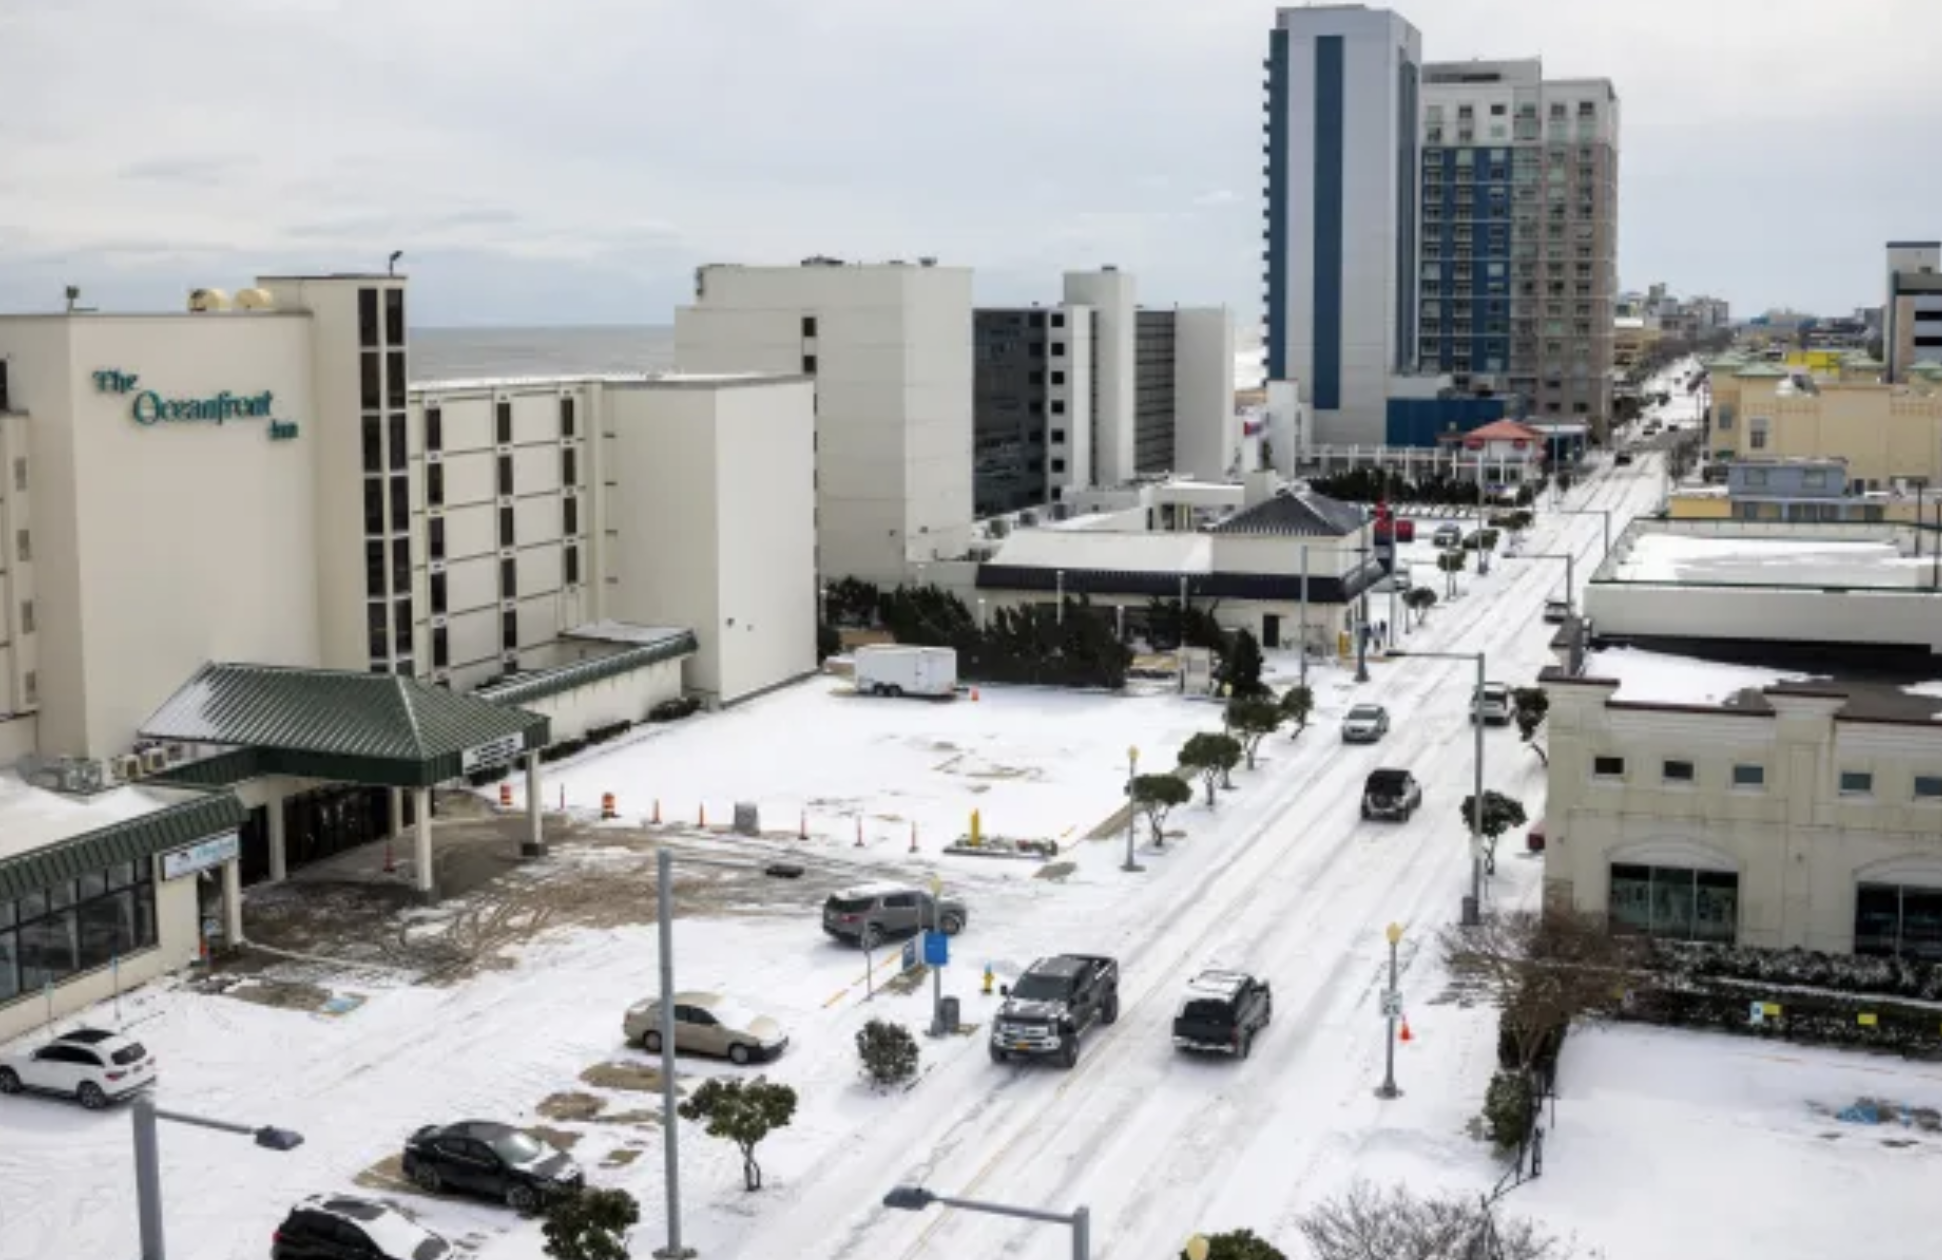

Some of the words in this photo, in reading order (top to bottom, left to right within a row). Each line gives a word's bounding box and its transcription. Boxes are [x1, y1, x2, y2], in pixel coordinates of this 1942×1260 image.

[92, 368, 138, 394] The
[133, 390, 273, 425] Oceanfront
[271, 419, 299, 440] Inn
